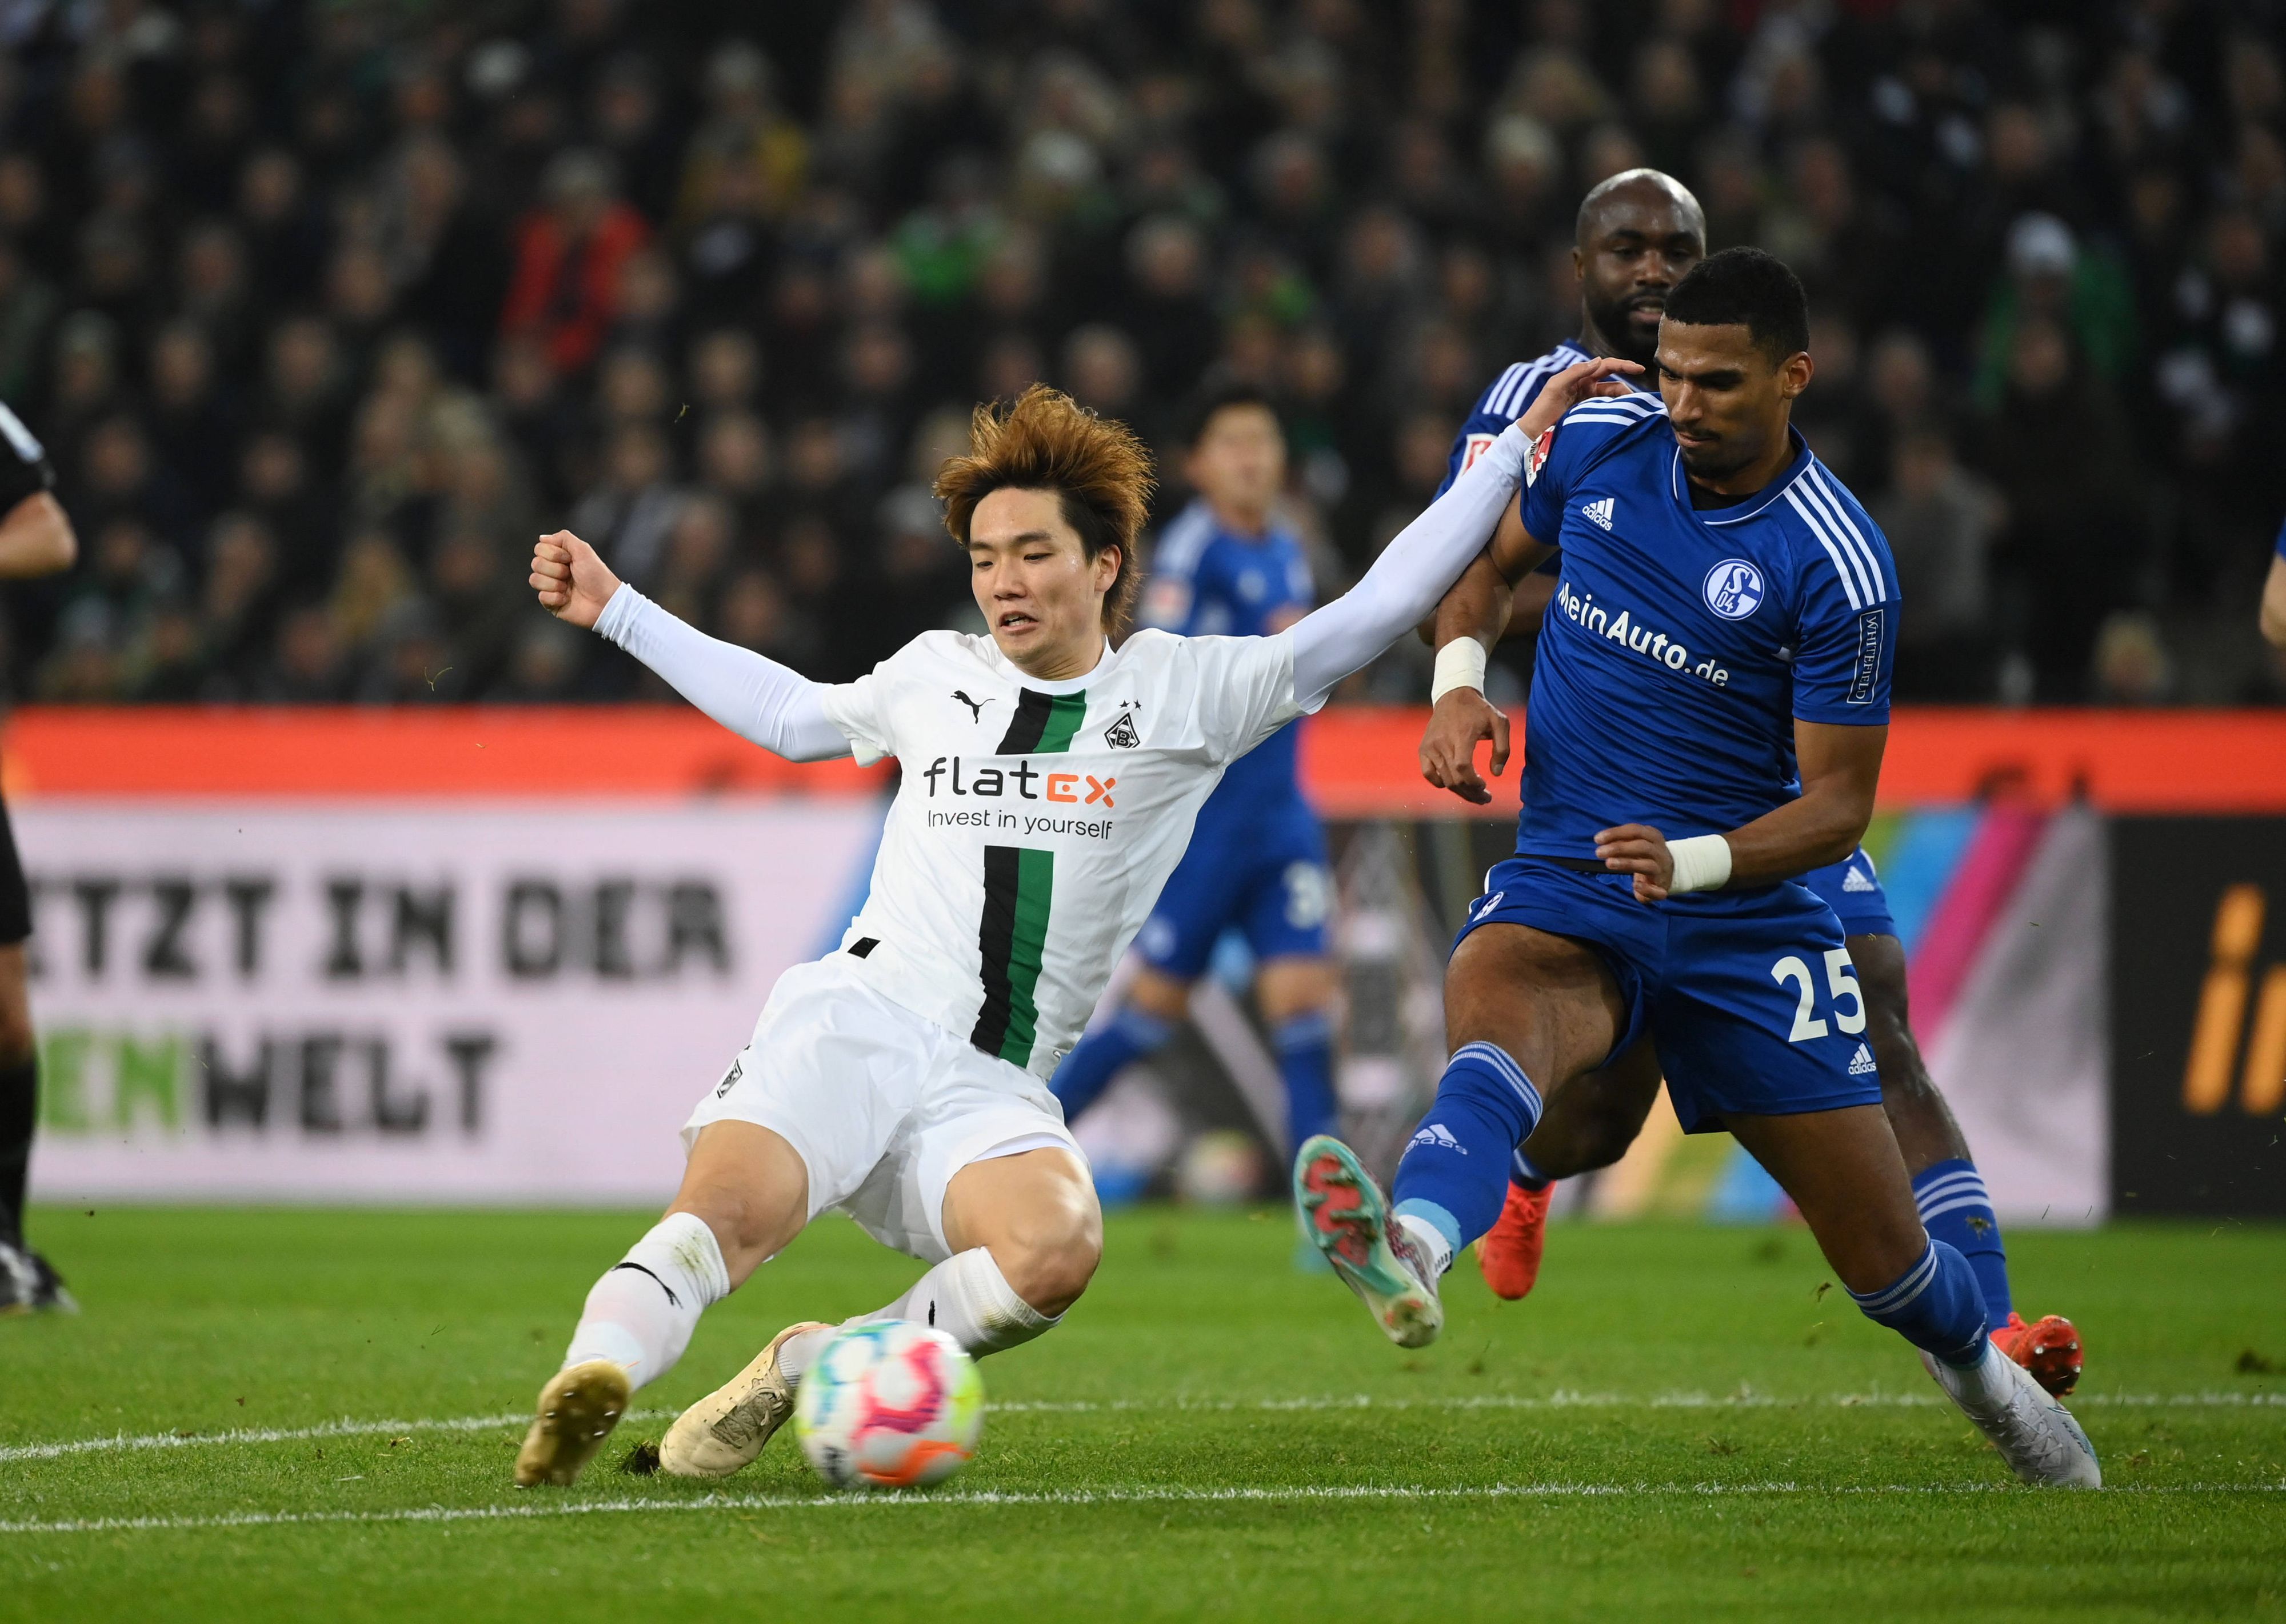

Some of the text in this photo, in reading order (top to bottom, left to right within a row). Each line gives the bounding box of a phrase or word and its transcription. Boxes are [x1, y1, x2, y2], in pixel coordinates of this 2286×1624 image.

[1582, 506, 1613, 531] adidas
[1558, 582, 1729, 687] MeinAuto.de
[1855, 615, 1879, 700] WHITEFIELD
[928, 809, 1113, 840] Invest in yourself
[325, 874, 455, 979] IN
[503, 874, 730, 979] DER
[1771, 947, 1867, 1043] 25
[35, 1027, 501, 1134] ENWELT
[1848, 1062, 1877, 1075] adidas
